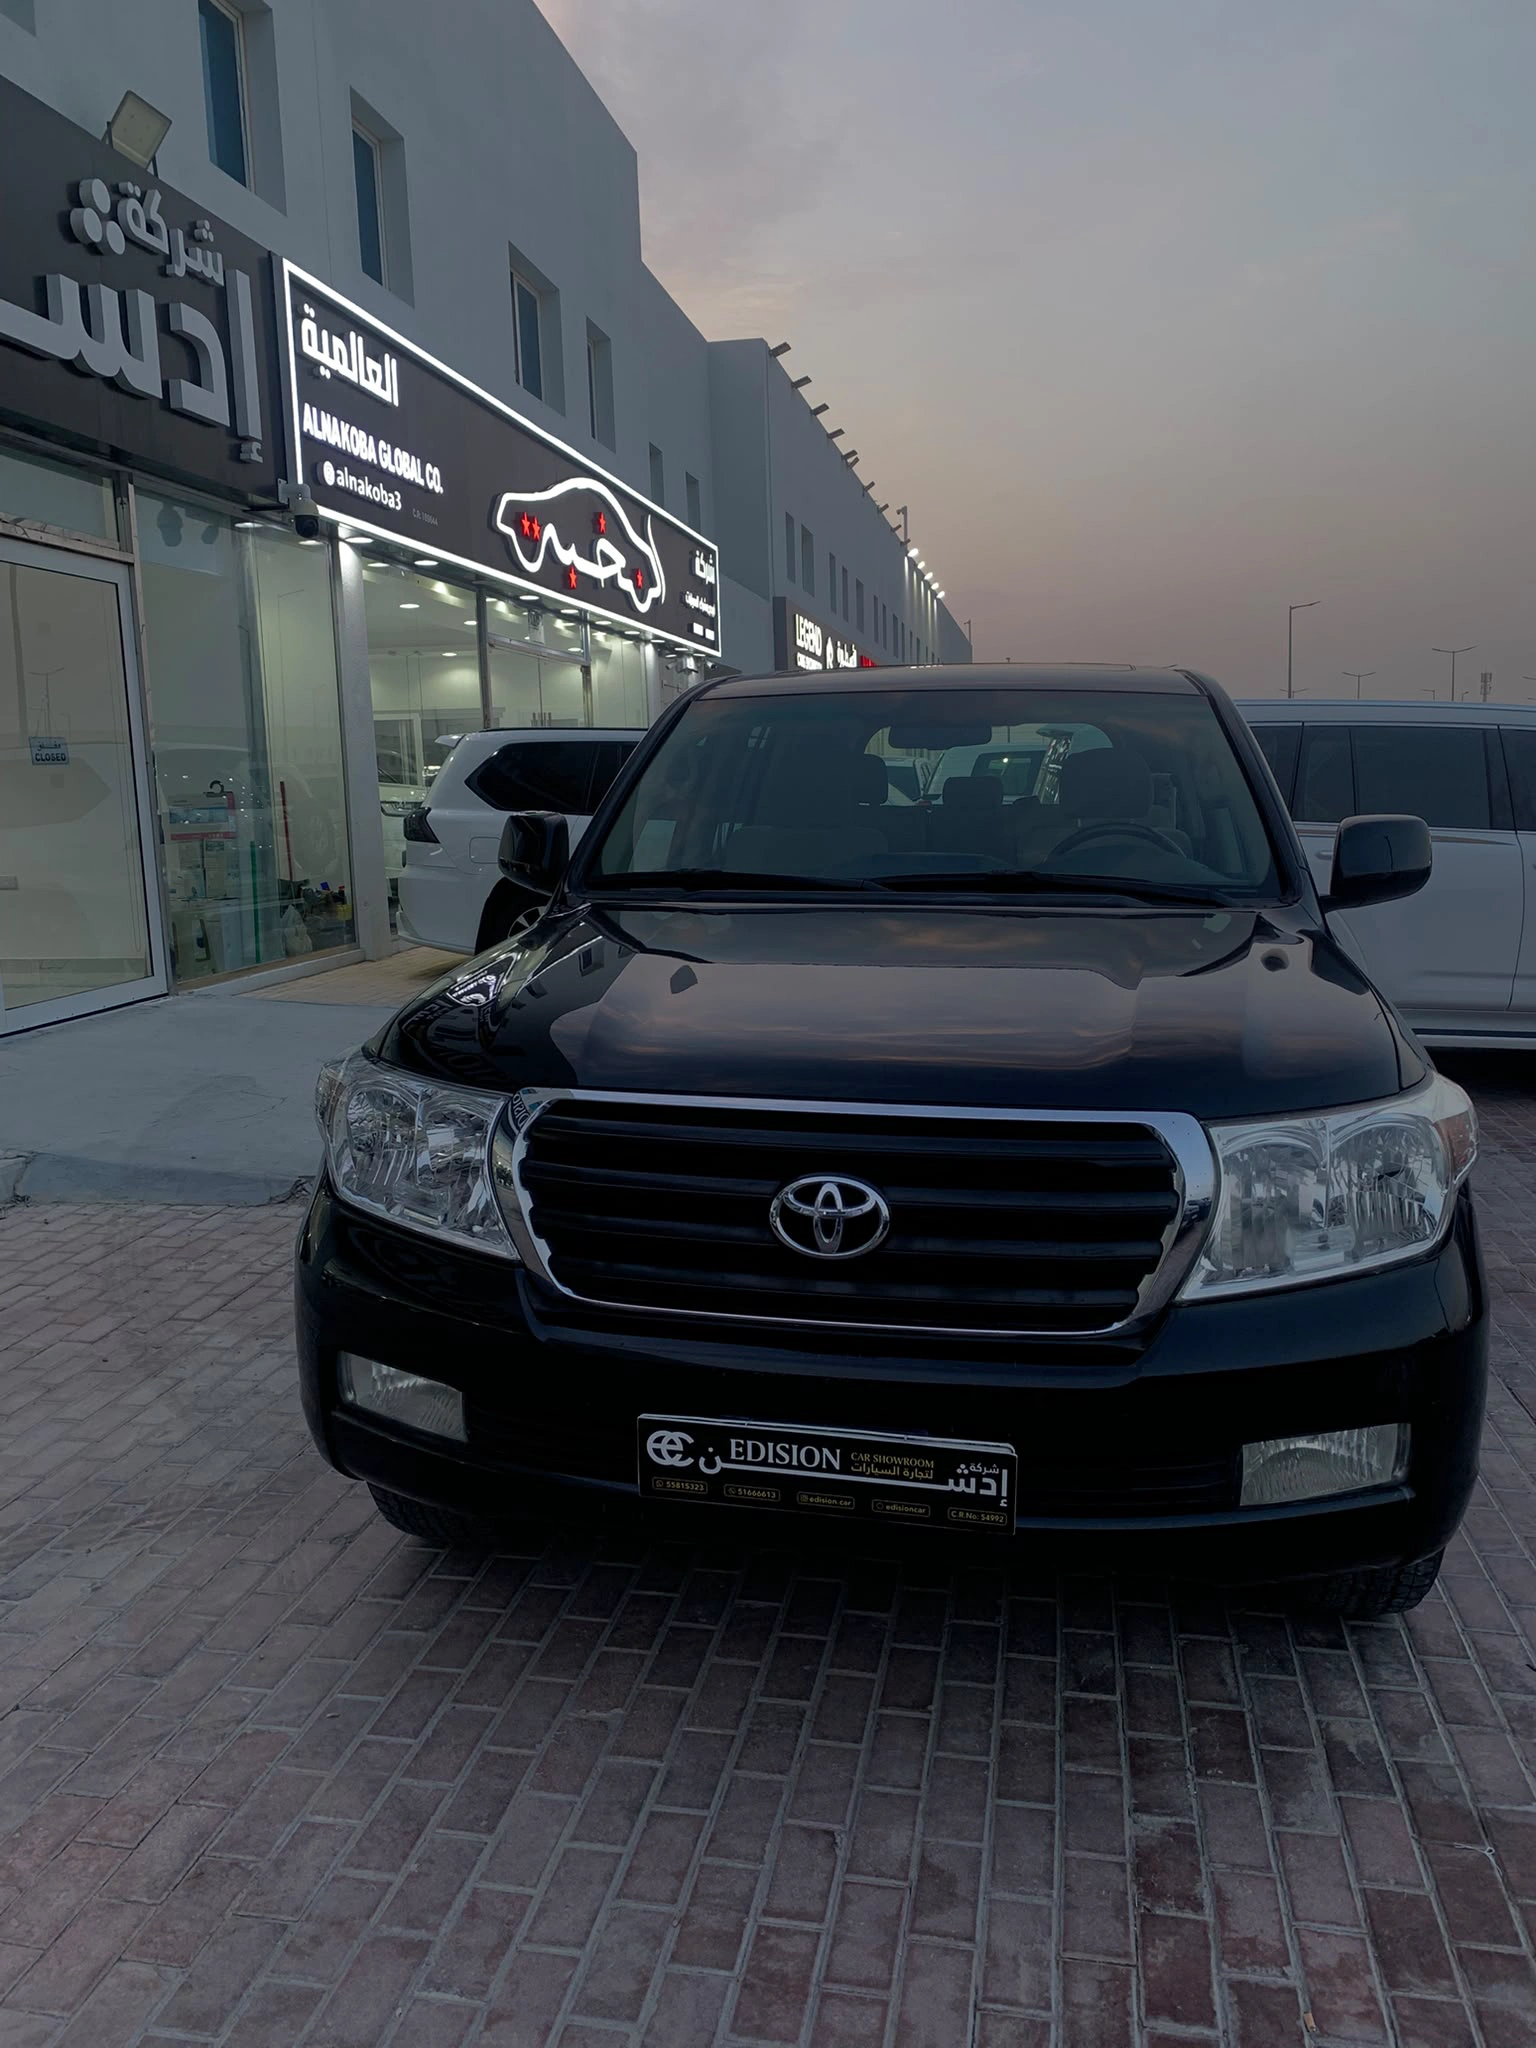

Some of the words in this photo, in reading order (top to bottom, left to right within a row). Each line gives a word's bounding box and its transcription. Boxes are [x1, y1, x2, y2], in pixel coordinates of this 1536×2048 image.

[114, 181, 224, 287] شركة
[300, 303, 399, 408] العالمية
[302, 402, 378, 465] ALNAKOBA
[378, 439, 425, 487] GLOBAL
[425, 462, 444, 495] CO.
[336, 466, 402, 511] alnakoba3
[35, 752, 66, 762] CLOSED
[729, 1438, 841, 1471] EDISION
[850, 1452, 871, 1462] CAR
[872, 1454, 934, 1469] SHOWROOM
[851, 1463, 901, 1477] السيارات
[902, 1468, 934, 1480] لتجارة
[969, 1462, 1000, 1475] شركة
[665, 1481, 705, 1492] 55815323
[737, 1488, 776, 1499] 51666613
[885, 1503, 926, 1515] edisioncar
